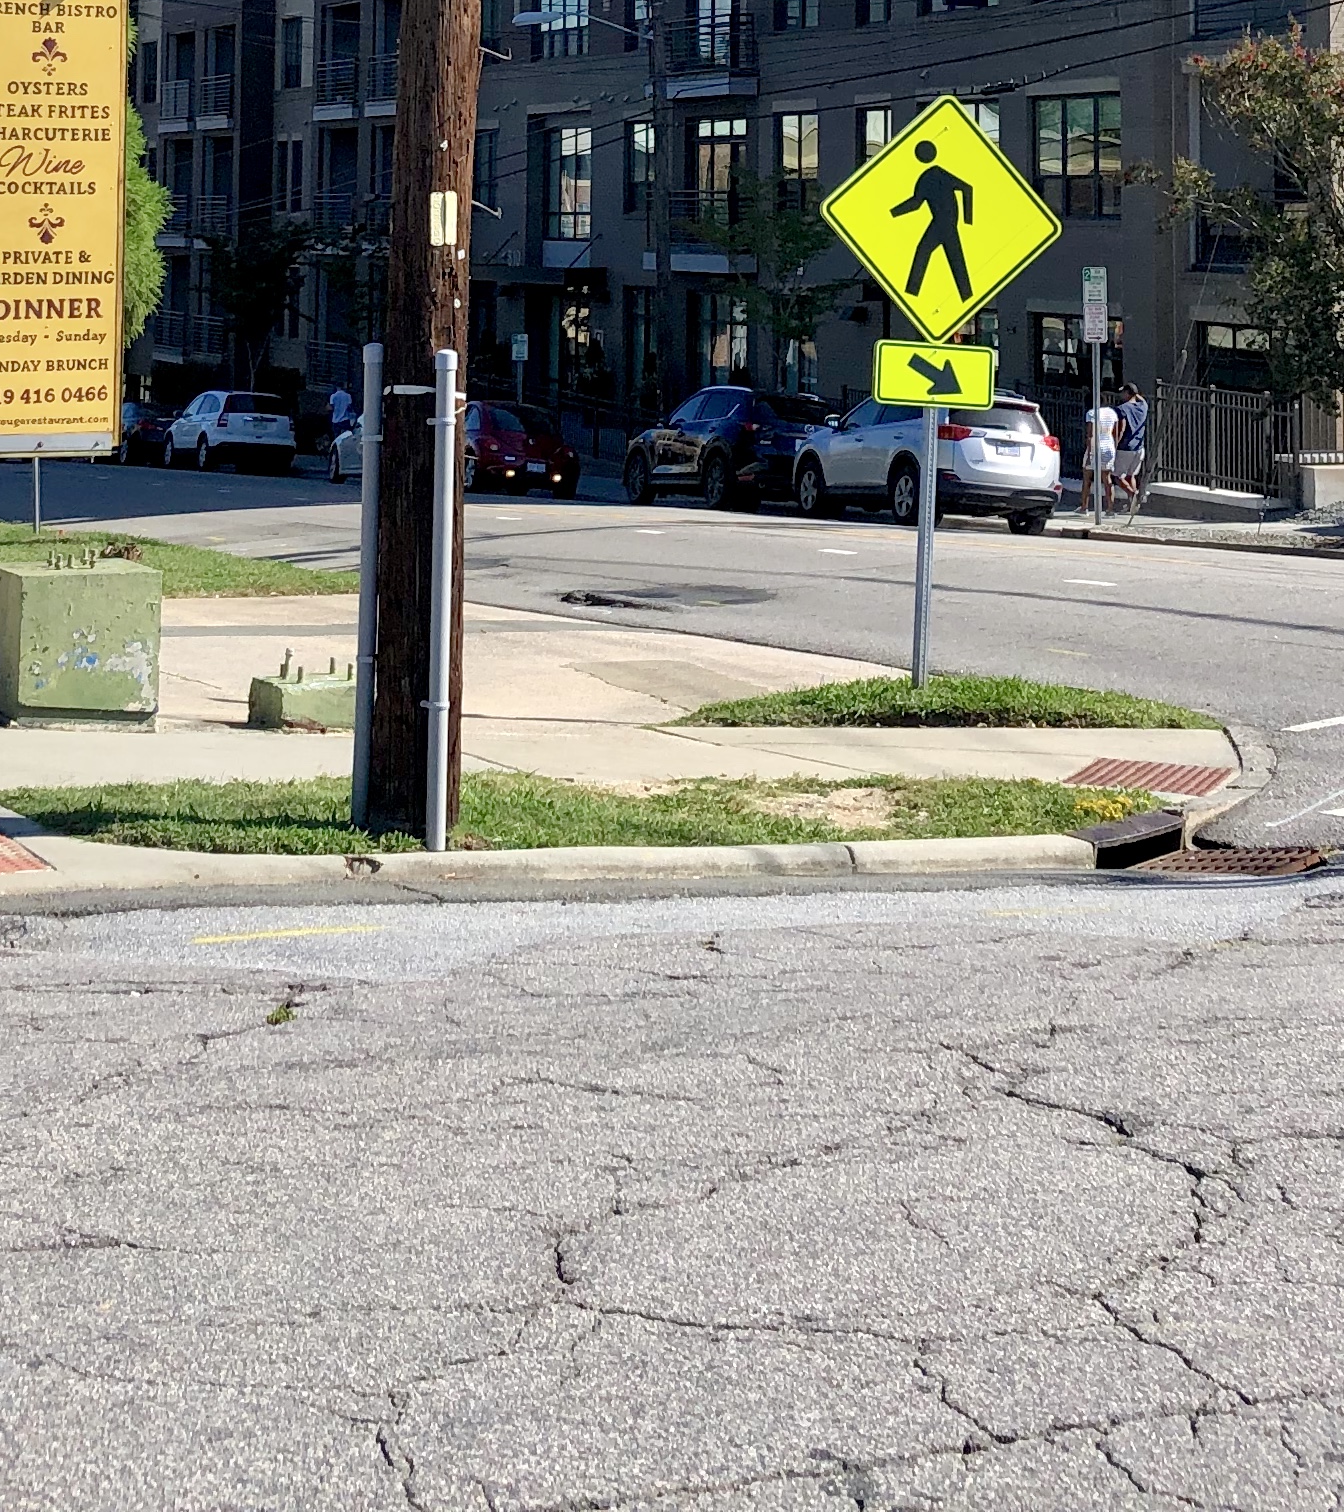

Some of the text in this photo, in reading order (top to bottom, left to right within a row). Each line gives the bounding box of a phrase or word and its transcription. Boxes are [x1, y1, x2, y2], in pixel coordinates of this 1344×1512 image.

[56, 4, 118, 19] BISTRO
[32, 21, 65, 34] BAR
[7, 81, 89, 96] OYSTERS
[47, 104, 111, 119] FRITES
[2, 250, 92, 265] PRIVATE &
[52, 270, 115, 285] DINING
[55, 329, 108, 345] Sunday
[45, 358, 110, 372] BRUNCH
[20, 388, 56, 404] 416
[61, 385, 109, 403] 0466
